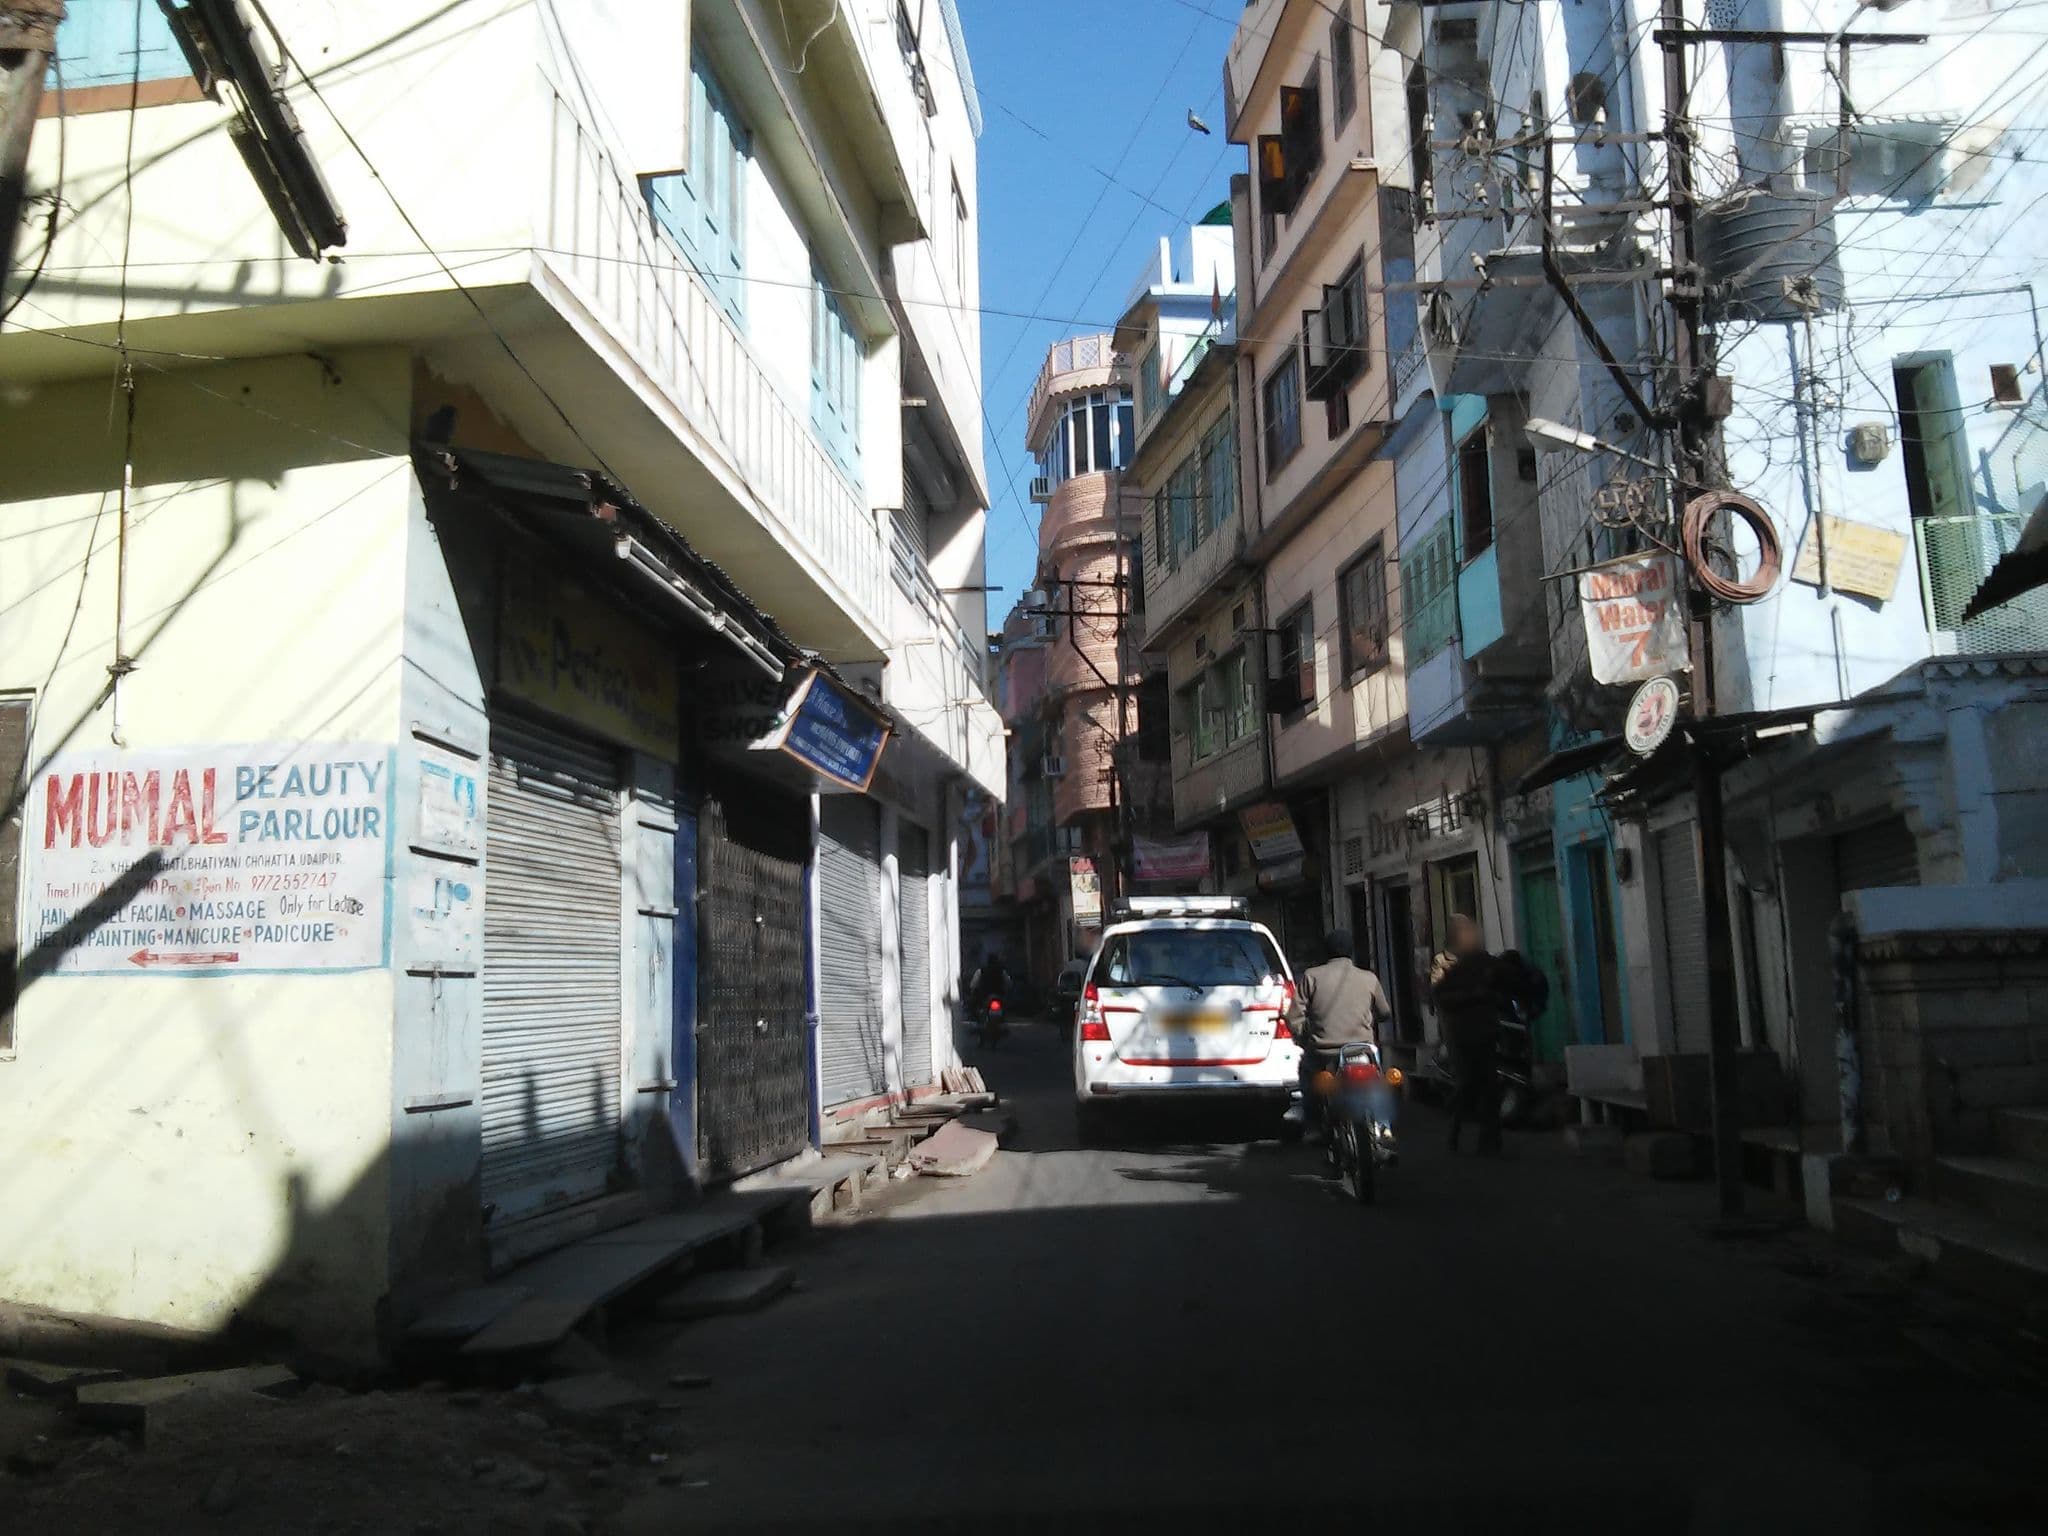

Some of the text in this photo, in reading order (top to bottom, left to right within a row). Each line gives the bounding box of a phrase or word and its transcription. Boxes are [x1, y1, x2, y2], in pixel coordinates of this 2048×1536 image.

[44, 760, 384, 850] MUMAL BEAUTY
[238, 806, 382, 844] PARLOUR
[300, 851, 342, 866] UDAIPUR
[46, 883, 69, 898] Time
[130, 904, 176, 923] FACIAL
[189, 900, 267, 921] MASSAGE
[279, 895, 304, 917] Only
[308, 894, 325, 911] for
[87, 928, 156, 947] PAINTING
[163, 925, 242, 945] MANICURE
[254, 922, 335, 943] PADICURE
